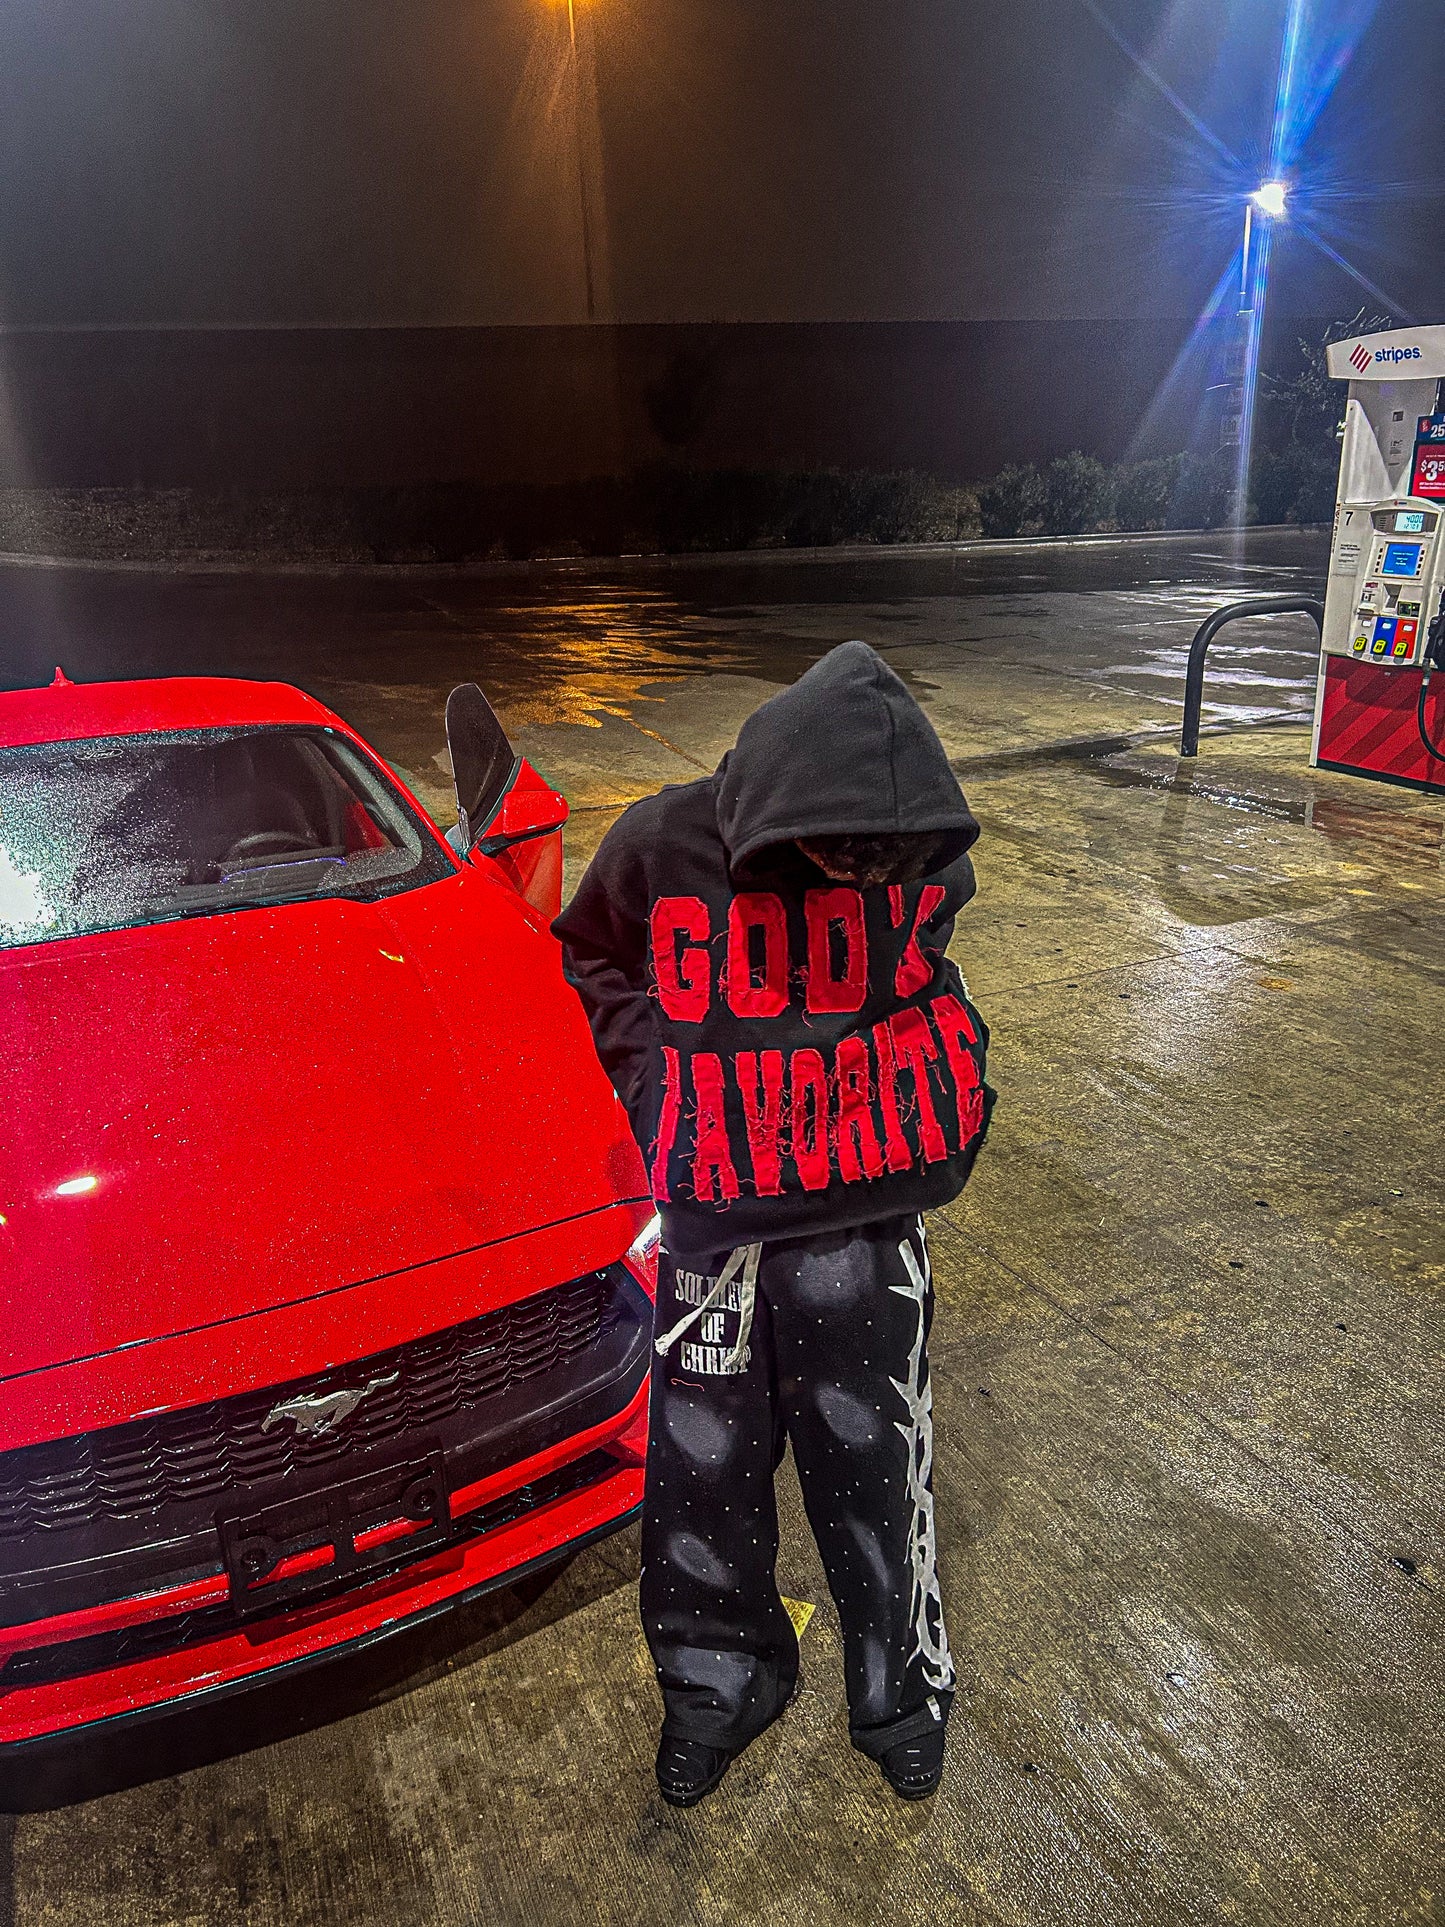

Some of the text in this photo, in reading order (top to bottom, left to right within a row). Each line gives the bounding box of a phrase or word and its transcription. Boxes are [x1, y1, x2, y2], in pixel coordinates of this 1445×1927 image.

[1345, 511, 1354, 526] 7
[83, 750, 115, 761] Ford
[700, 1311, 725, 1344] OF
